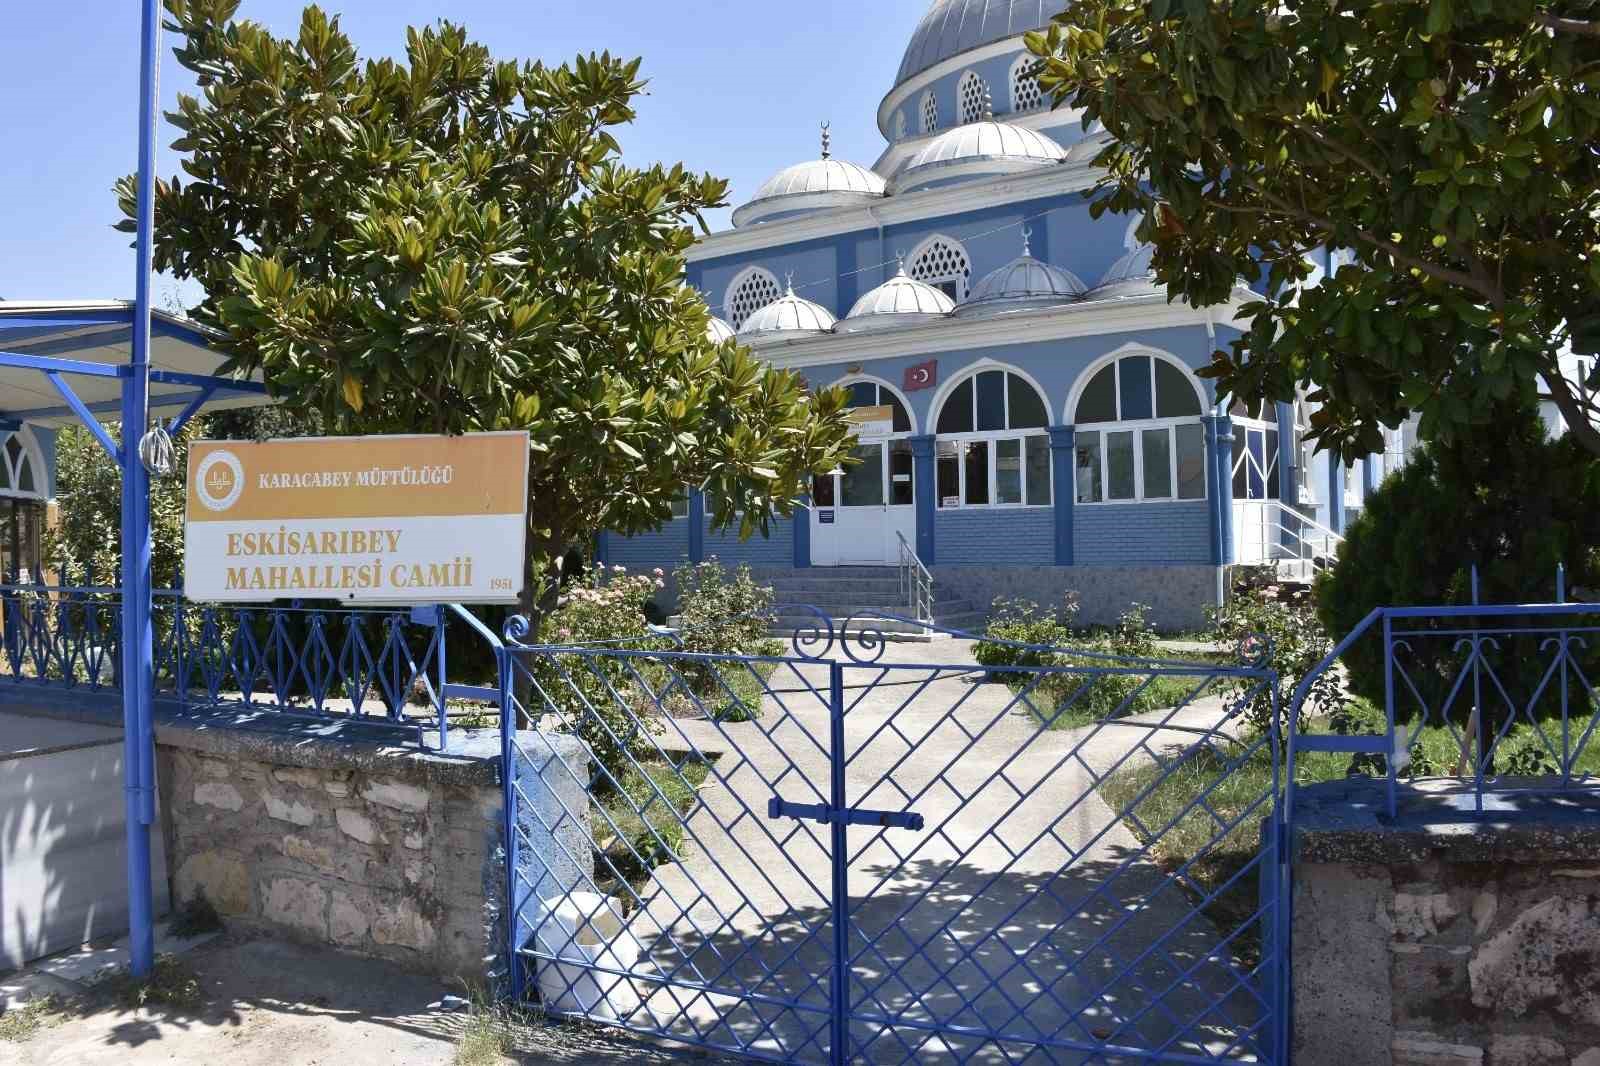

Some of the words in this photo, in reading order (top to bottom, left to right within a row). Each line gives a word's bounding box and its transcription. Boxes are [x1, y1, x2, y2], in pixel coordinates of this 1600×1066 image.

[258, 471, 352, 489] KARACABEY
[356, 465, 454, 486] MÜFTÜLÜĞÜ
[226, 525, 403, 556] ESKİSARIBEY
[225, 558, 383, 591] MAHALLESİ
[391, 556, 473, 588] CAMİİ
[489, 578, 513, 590] 1951
